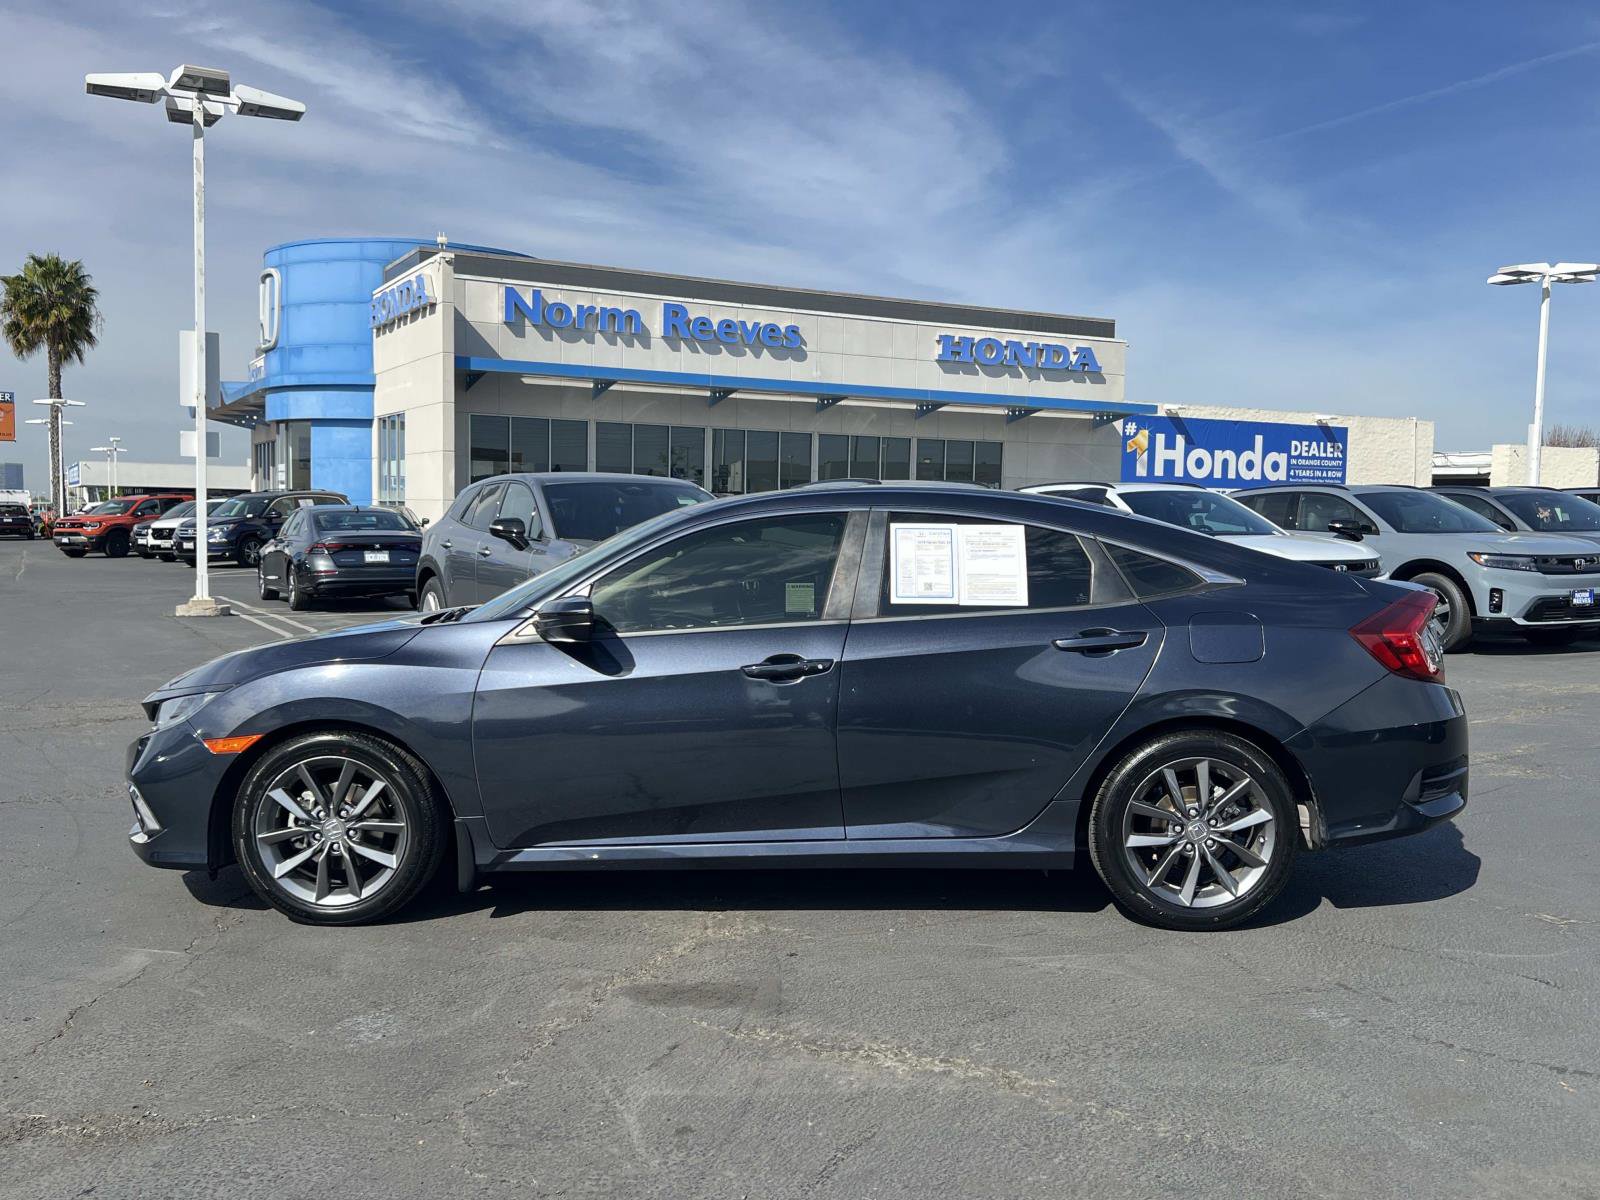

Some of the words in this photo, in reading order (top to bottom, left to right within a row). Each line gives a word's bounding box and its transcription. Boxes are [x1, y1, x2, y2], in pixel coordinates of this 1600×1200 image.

[367, 273, 430, 329] HONDA
[504, 286, 642, 334] Norm
[662, 302, 801, 348] Reeves
[936, 334, 1103, 372] HONDA
[1154, 433, 1288, 482] Honda
[1291, 440, 1343, 457] DEALER
